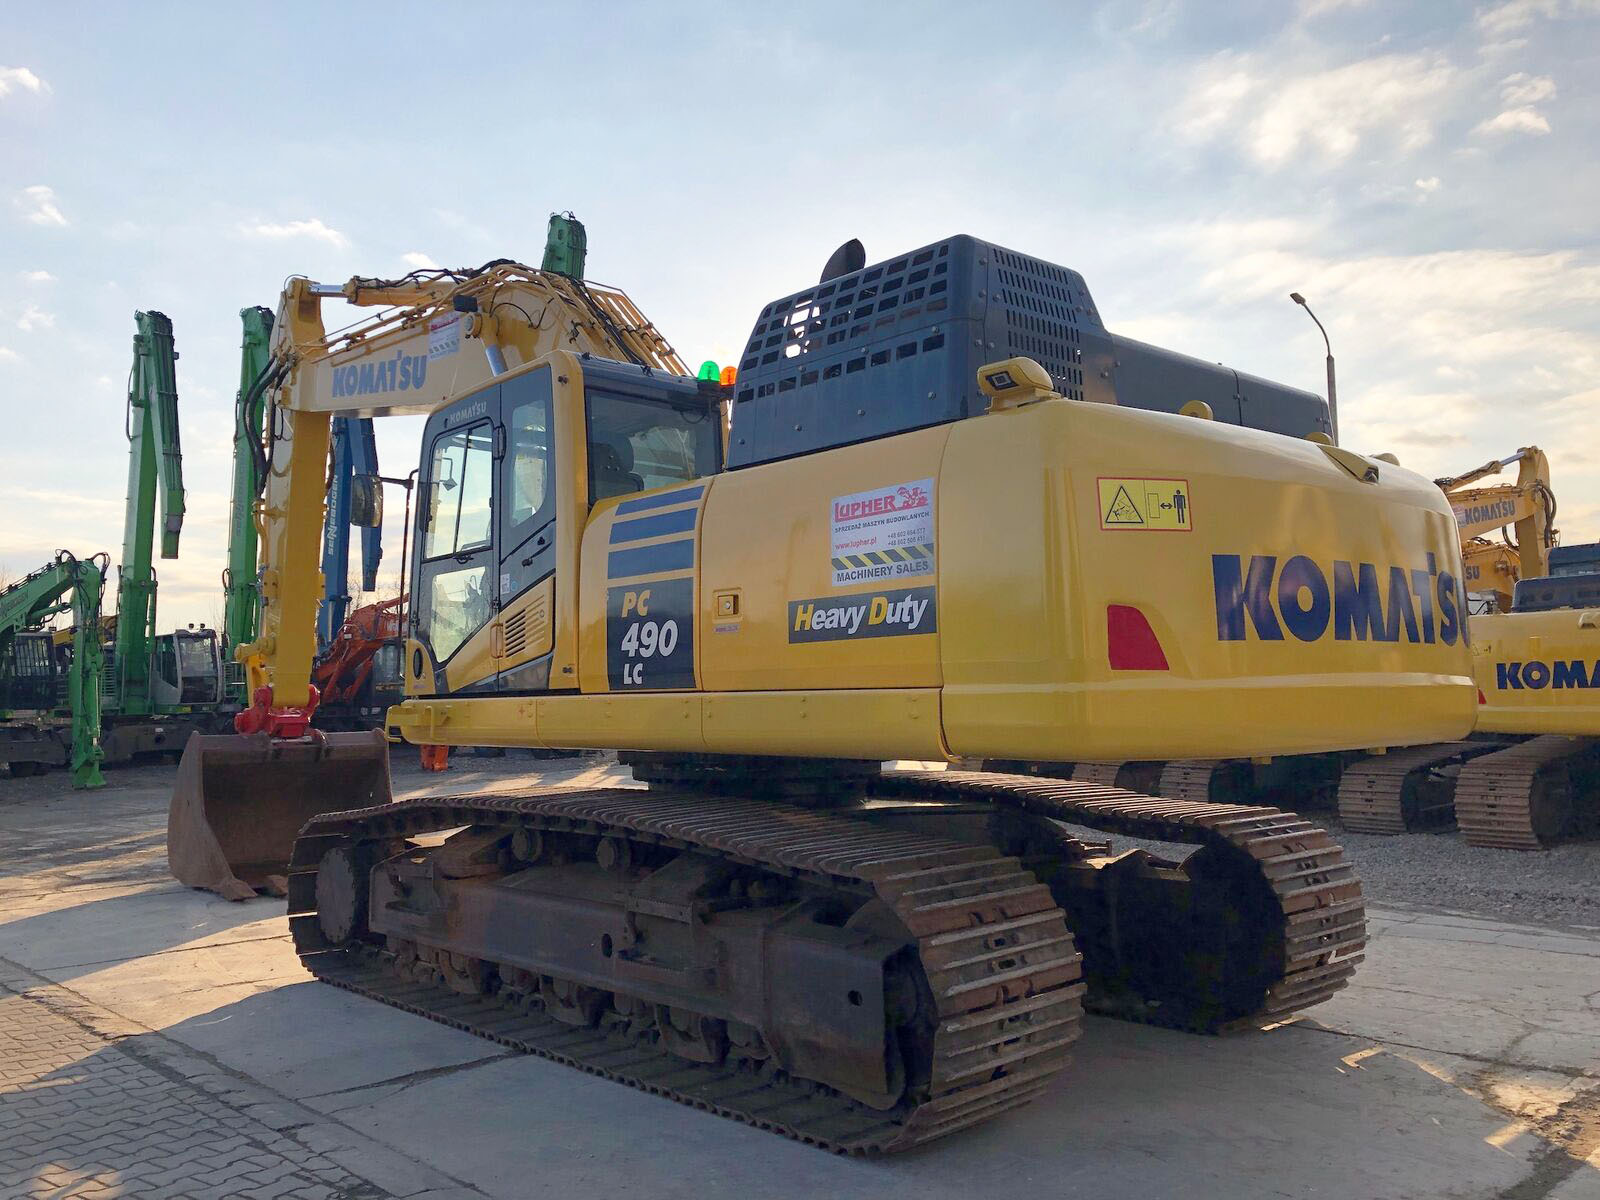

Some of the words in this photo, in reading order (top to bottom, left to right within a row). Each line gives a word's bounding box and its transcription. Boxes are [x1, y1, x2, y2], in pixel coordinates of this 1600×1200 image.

[332, 350, 427, 398] KOMATSU
[451, 401, 487, 423] KOMATSU
[834, 495, 897, 523] LUPHER
[834, 523, 861, 534] SPRZEDAŻ
[862, 519, 885, 528] MASZYN
[886, 511, 930, 525] BUDOWLANYCH
[1464, 497, 1516, 525] KOMATSU
[834, 536, 877, 550] www.lupher.pl
[837, 565, 893, 582] MACHINERY
[896, 560, 928, 575] SALES
[621, 589, 651, 618] PC
[794, 603, 867, 635] Heavy
[868, 594, 929, 630] Duty
[621, 619, 678, 657] 490
[623, 663, 643, 685] LC
